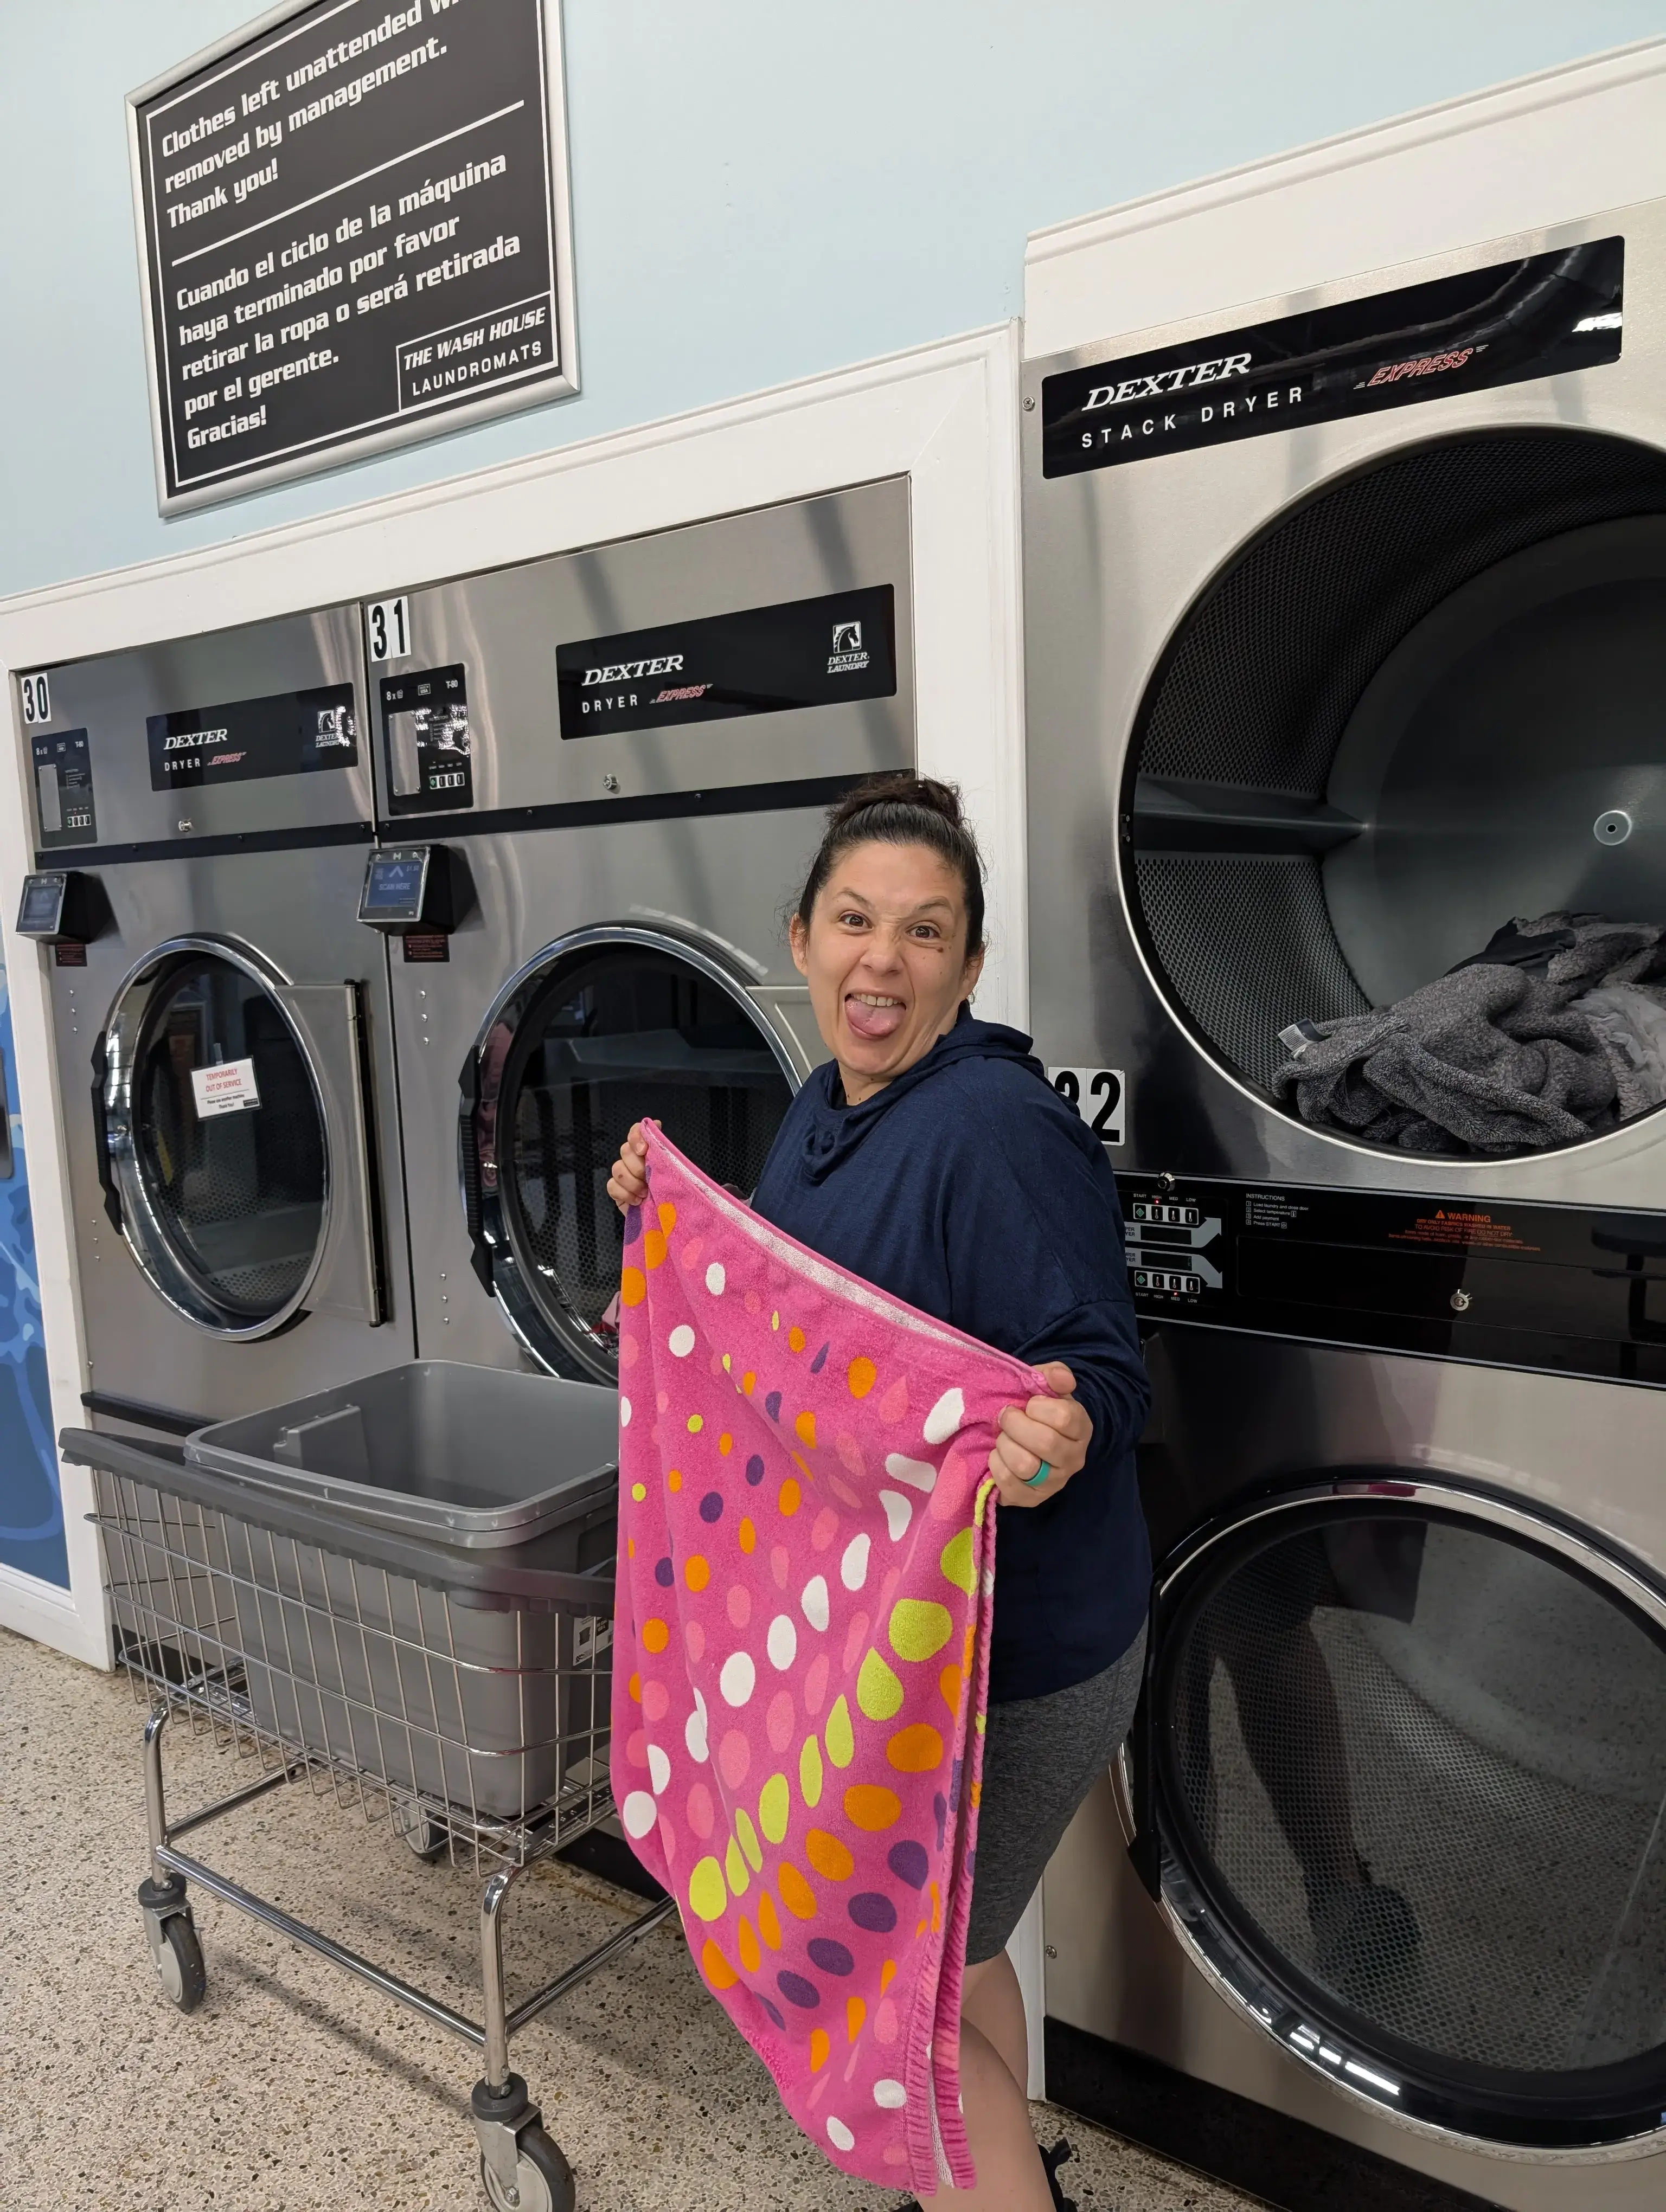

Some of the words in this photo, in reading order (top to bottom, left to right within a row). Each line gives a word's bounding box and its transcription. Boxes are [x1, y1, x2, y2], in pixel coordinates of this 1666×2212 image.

[162, 106, 236, 158] Clothes
[241, 80, 280, 117] left
[286, 2, 422, 92] unattended
[165, 132, 251, 194] removed
[255, 121, 282, 149] by
[288, 37, 447, 132] management.
[166, 186, 229, 228] Thank
[233, 158, 278, 203] you!
[177, 267, 249, 311] Cuando
[255, 252, 274, 279] el
[281, 233, 329, 267] ciclo
[336, 218, 363, 245] de
[370, 204, 392, 229] la
[399, 155, 507, 216] máquina
[179, 314, 229, 346] haya
[234, 266, 343, 324] terminado
[350, 246, 388, 284] por
[394, 216, 460, 259] favor
[182, 342, 249, 381] retirar
[255, 332, 274, 354] la
[280, 312, 330, 345] ropa
[336, 303, 350, 323] o
[357, 274, 408, 315] será
[415, 236, 520, 292] retirada
[404, 346, 433, 371] THE
[437, 328, 485, 359] WASH
[489, 306, 546, 348] HOUSE
[184, 390, 218, 420] por
[223, 376, 242, 402] el
[248, 349, 339, 398] gerente.
[412, 340, 541, 396] LAUNDROMATS
[1081, 352, 1252, 411] DEXTER
[1081, 413, 1176, 448] STACK
[1201, 388, 1302, 421] DRYER
[1367, 348, 1474, 386] EXPRESS
[187, 404, 267, 449] Gracias!
[370, 601, 407, 658] 31
[581, 655, 684, 686] DEXTER
[827, 652, 868, 666] DEXTER
[827, 661, 869, 673] LAUNDRY
[23, 676, 49, 723] 30
[386, 691, 391, 700] 8
[445, 679, 458, 689] T-80
[582, 694, 639, 713] DRYER
[657, 684, 705, 702] EXPRESS
[164, 729, 227, 750] DEXTER
[164, 758, 201, 771] DRYER
[211, 753, 242, 765] EXPRESS
[206, 1069, 238, 1081] TEMPORARILY
[206, 1084, 215, 1092] OUT
[223, 1078, 242, 1089] SERVICE
[1246, 1193, 1285, 1201] INSTRUCTIONS
[1447, 1212, 1491, 1223] WARNING
